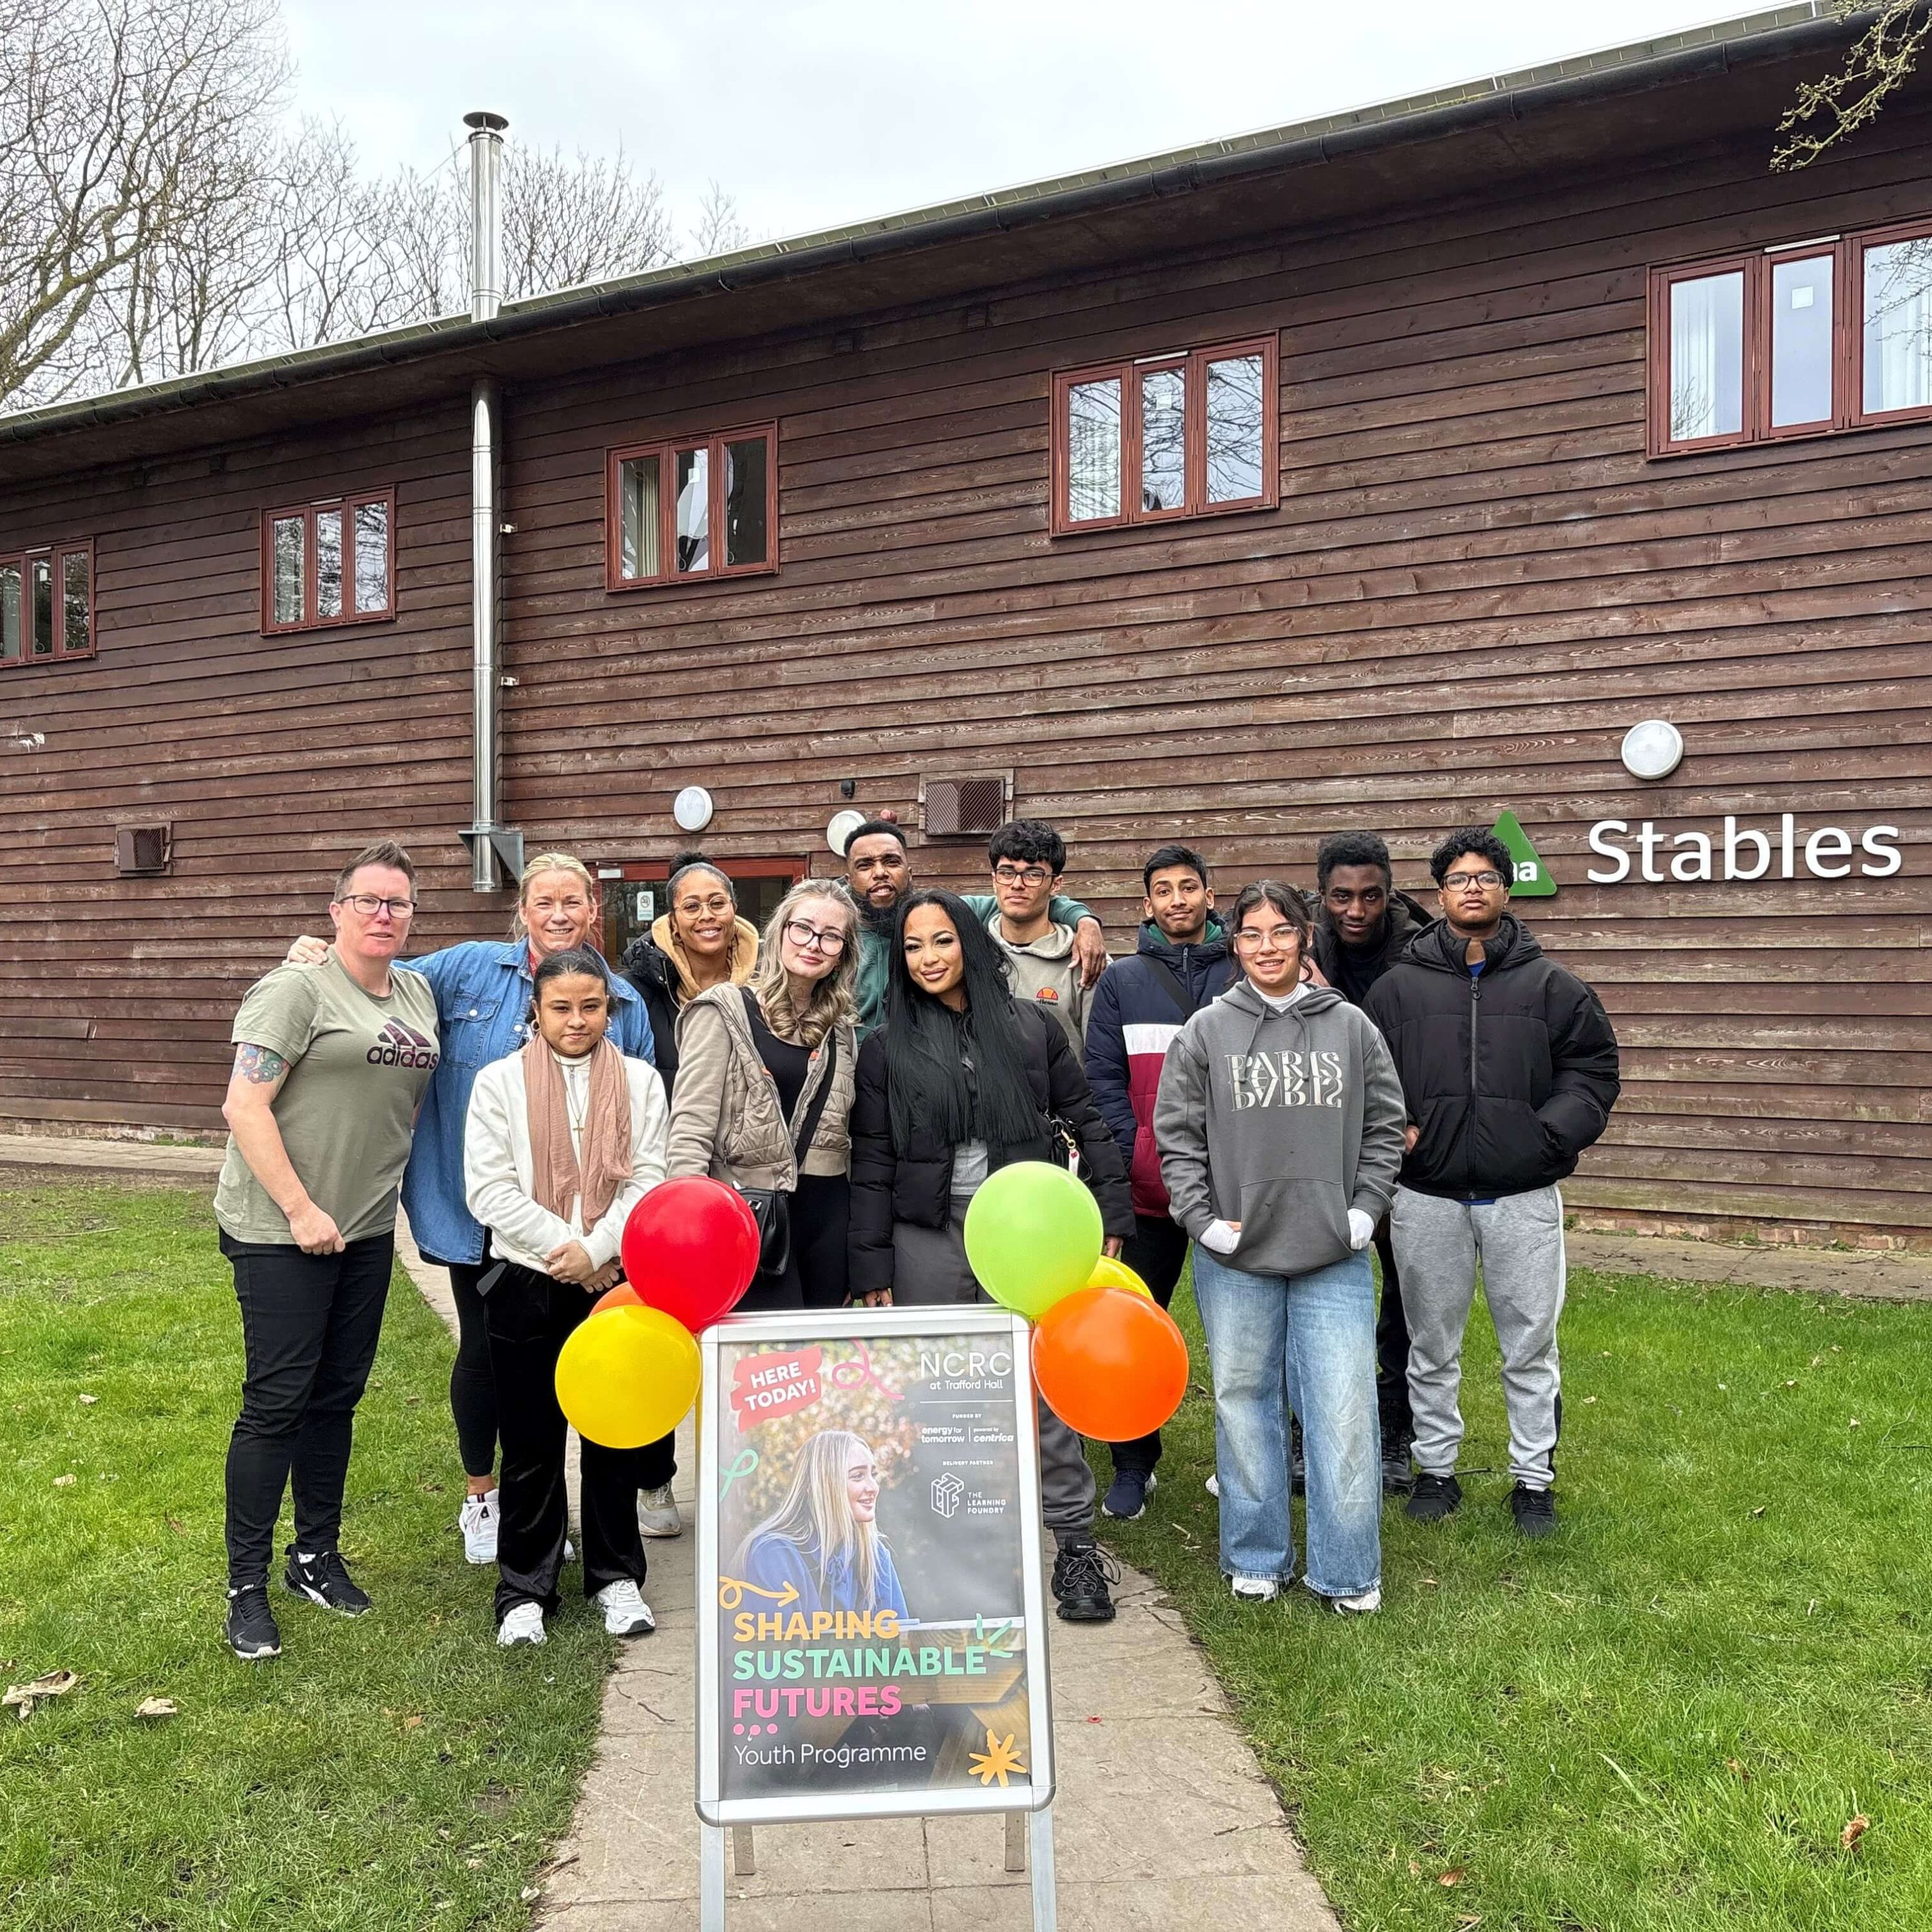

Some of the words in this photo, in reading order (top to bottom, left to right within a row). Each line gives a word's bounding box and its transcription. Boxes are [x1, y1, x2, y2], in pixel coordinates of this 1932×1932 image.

[1587, 813, 1902, 884] Stables
[366, 1043, 439, 1070] adidas
[750, 1361, 802, 1388] HERE
[920, 1352, 1011, 1378] NCRC
[744, 1378, 816, 1410] TODAY!
[930, 1381, 941, 1390] at
[945, 1380, 981, 1390] Trafford
[984, 1379, 1003, 1389] Hall
[973, 1433, 1014, 1443] centrica
[733, 1609, 900, 1642] SHAPING
[732, 1645, 987, 1680] SUSTAINABLE
[733, 1685, 902, 1718] FUTURES
[734, 1744, 795, 1765] Youth
[801, 1744, 927, 1768] Programme
